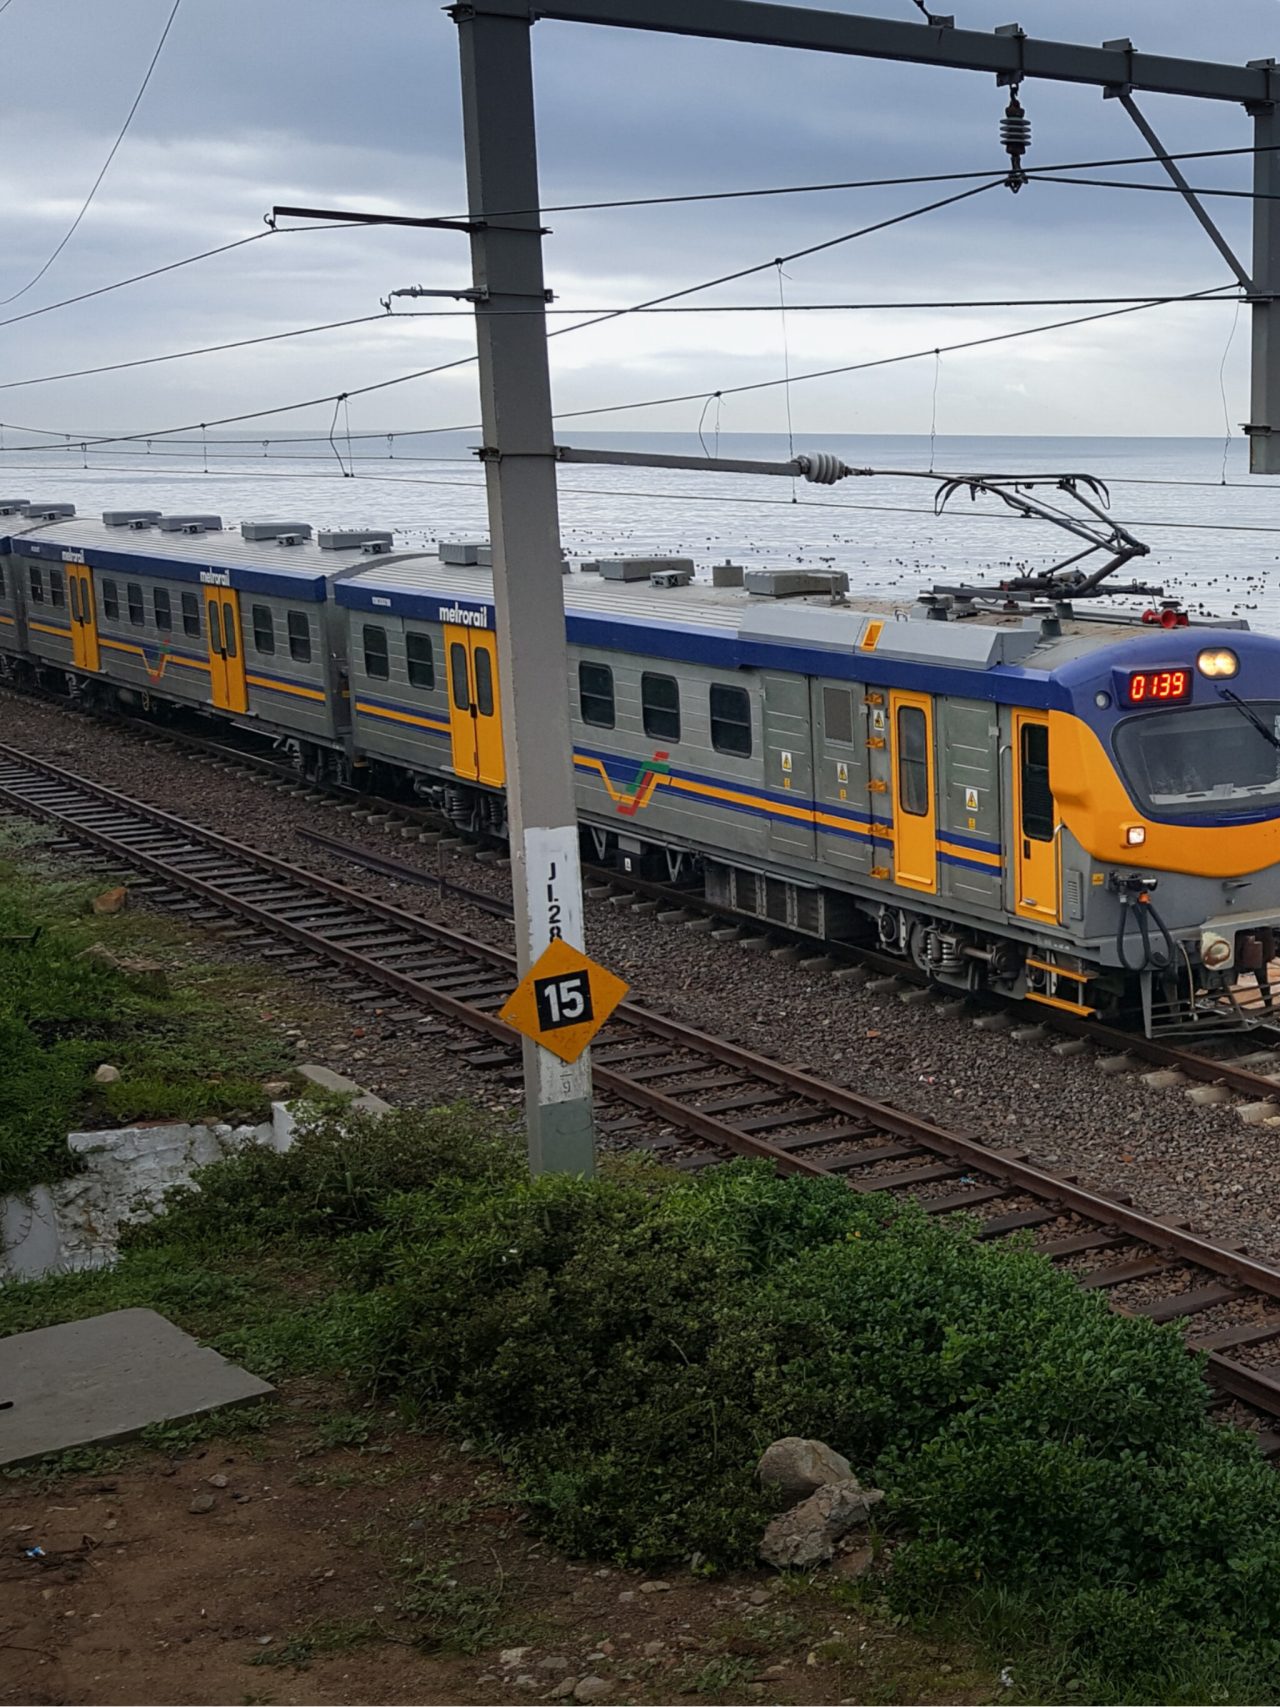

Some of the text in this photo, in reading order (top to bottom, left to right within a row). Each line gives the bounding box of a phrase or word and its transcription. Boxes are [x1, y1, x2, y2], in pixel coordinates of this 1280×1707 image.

[199, 566, 230, 586] metrorail
[439, 601, 487, 628] metrorail
[1132, 672, 1184, 699] 0139
[544, 978, 585, 1022] 15
